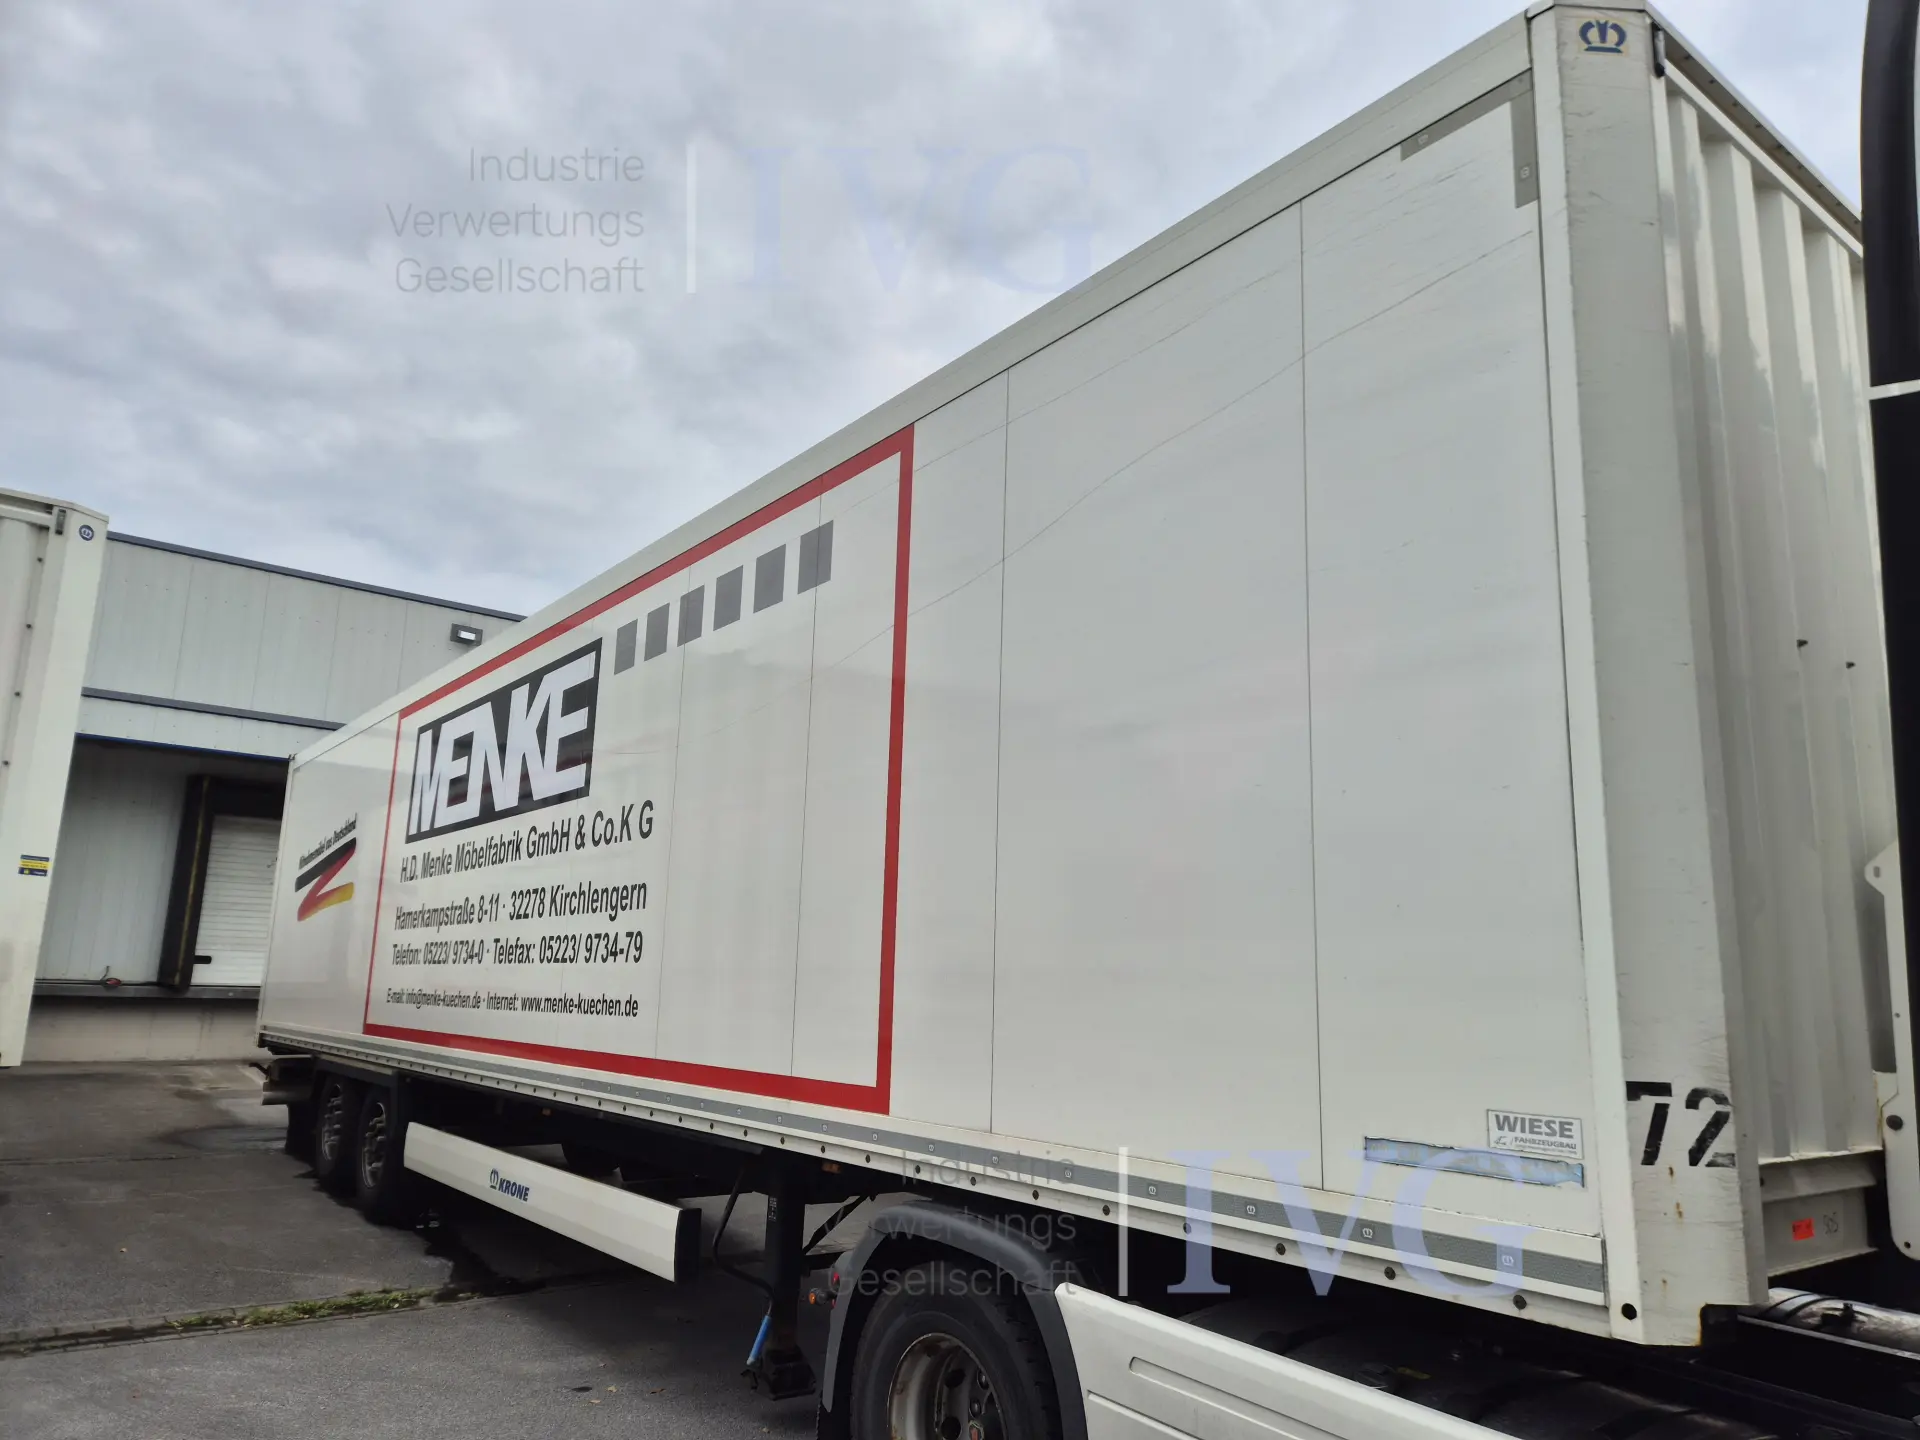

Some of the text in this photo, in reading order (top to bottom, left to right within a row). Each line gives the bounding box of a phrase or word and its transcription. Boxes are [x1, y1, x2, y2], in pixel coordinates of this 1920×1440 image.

[408, 650, 597, 836] MENKE
[400, 857, 418, 883] H.D.
[421, 850, 452, 879] Menke
[454, 835, 523, 873] Möbelfabrik
[526, 817, 571, 859] GmbH
[574, 814, 586, 850] &
[395, 896, 475, 933] Hamerkampstraße
[477, 894, 500, 923] 8-11
[509, 886, 546, 921] 32278
[548, 880, 647, 922] Kirchlengern
[392, 943, 422, 965] Telefon:
[493, 936, 536, 965] Telefax:
[584, 930, 643, 964] 9734-79
[486, 991, 519, 1012] Internet:
[520, 992, 639, 1018] www.menke-kuechen.de
[1494, 1113, 1574, 1139] WIESE
[1625, 1080, 1736, 1168] 72
[1513, 1136, 1577, 1150] FAHRZEUGBAU
[498, 1177, 530, 1202] KRONE
